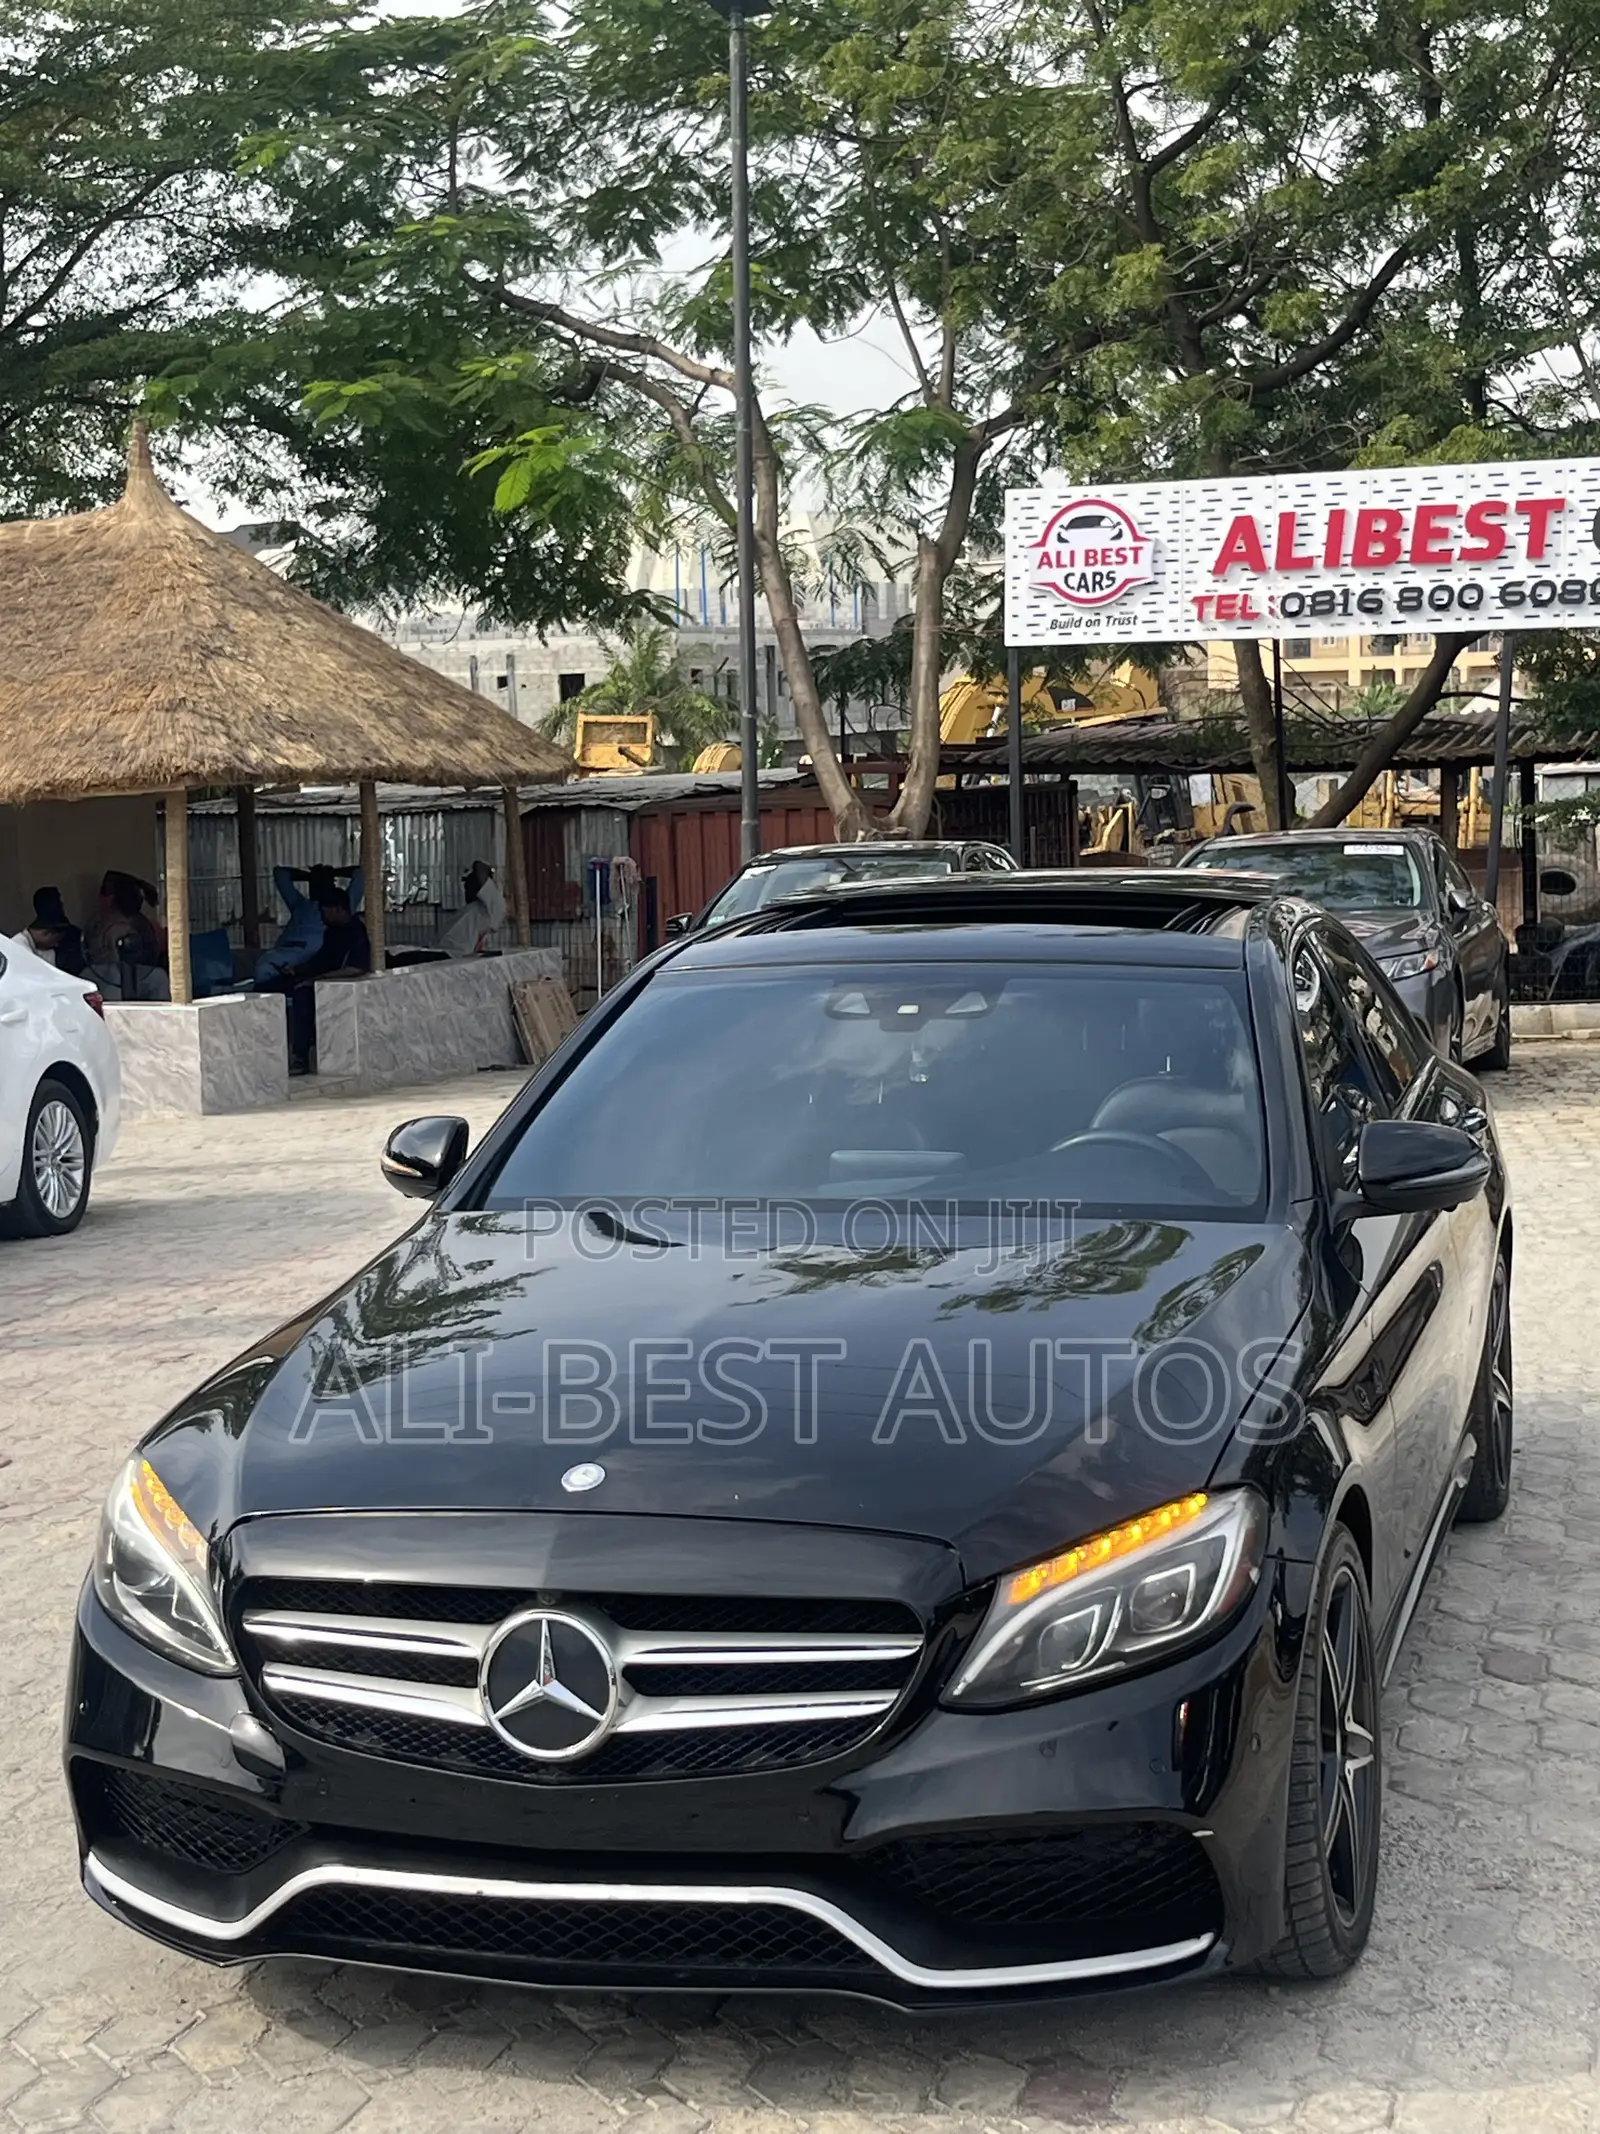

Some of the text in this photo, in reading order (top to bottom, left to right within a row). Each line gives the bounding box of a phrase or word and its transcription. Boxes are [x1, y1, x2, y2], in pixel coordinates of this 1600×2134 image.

[1211, 498, 1566, 577] ALIBEST
[1037, 546, 1144, 569] ALI BEST
[1063, 570, 1117, 593] CARS
[1280, 588, 1385, 619] 0816
[1397, 583, 1484, 613] 800
[1050, 615, 1138, 630] Build on Trust
